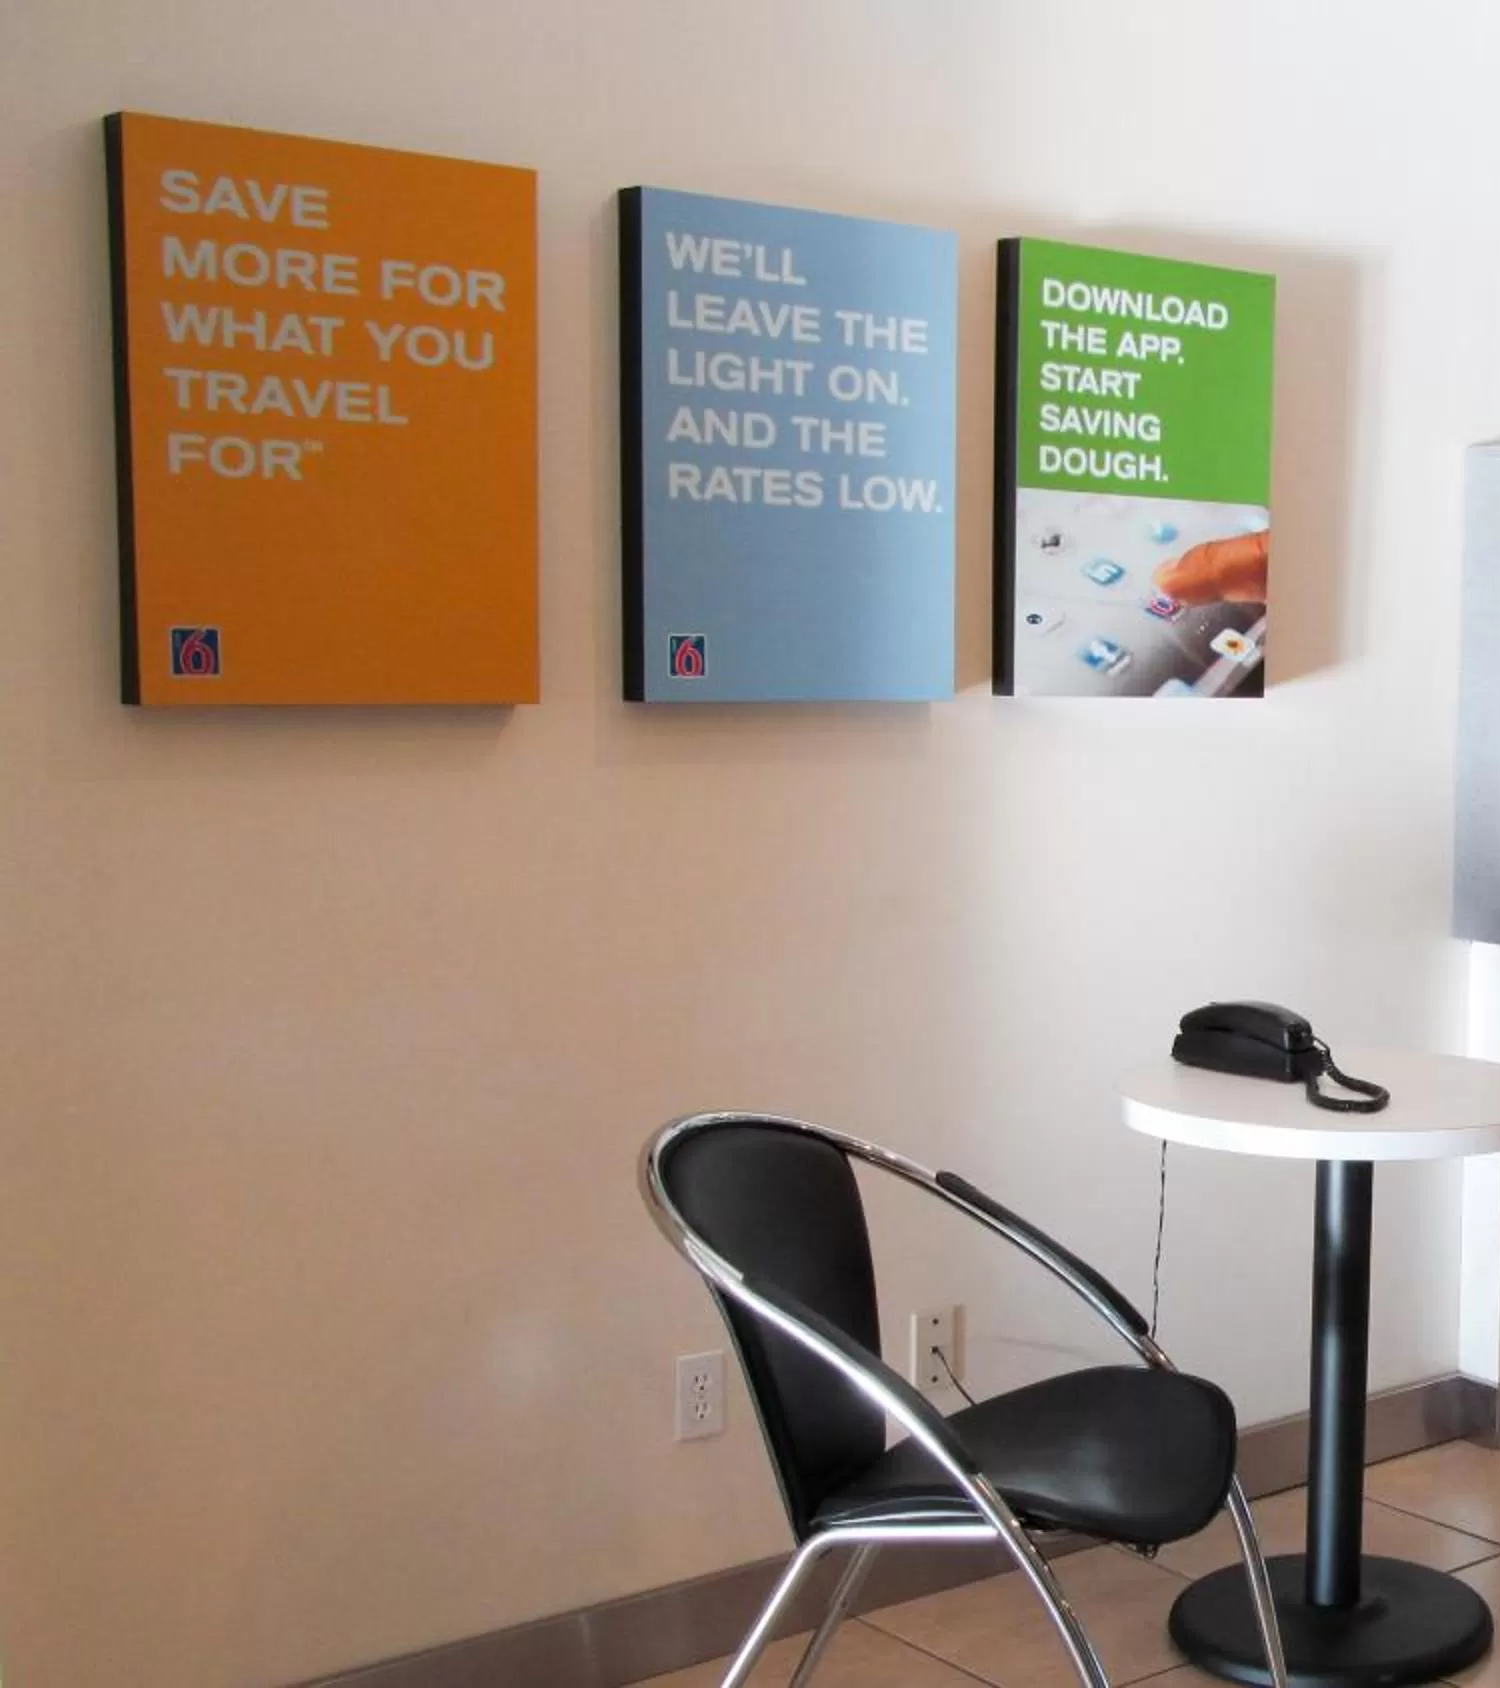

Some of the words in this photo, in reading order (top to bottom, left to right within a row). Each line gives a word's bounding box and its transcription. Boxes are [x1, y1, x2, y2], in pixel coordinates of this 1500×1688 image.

[160, 168, 330, 230] SAVE
[160, 235, 359, 297] MORE
[381, 259, 506, 313] FOR
[665, 231, 807, 287] WE'LL
[666, 290, 822, 344] LEAVE
[835, 311, 929, 354] THE
[1042, 278, 1229, 331] DOWNLOAD
[160, 301, 343, 357] WHAT
[365, 319, 495, 371] YOU
[1040, 320, 1107, 355] THE
[1117, 331, 1185, 365] APP.
[163, 367, 409, 425] TRAVEL
[666, 349, 814, 397] LIGHT
[828, 365, 910, 407] ON.
[1040, 362, 1141, 400] START
[665, 406, 777, 449] AND
[791, 416, 887, 458] THE
[1039, 404, 1161, 442] SAVING
[667, 464, 824, 507] RATES
[839, 476, 944, 514] LOW.
[1038, 445, 1169, 482] DOUGH.
